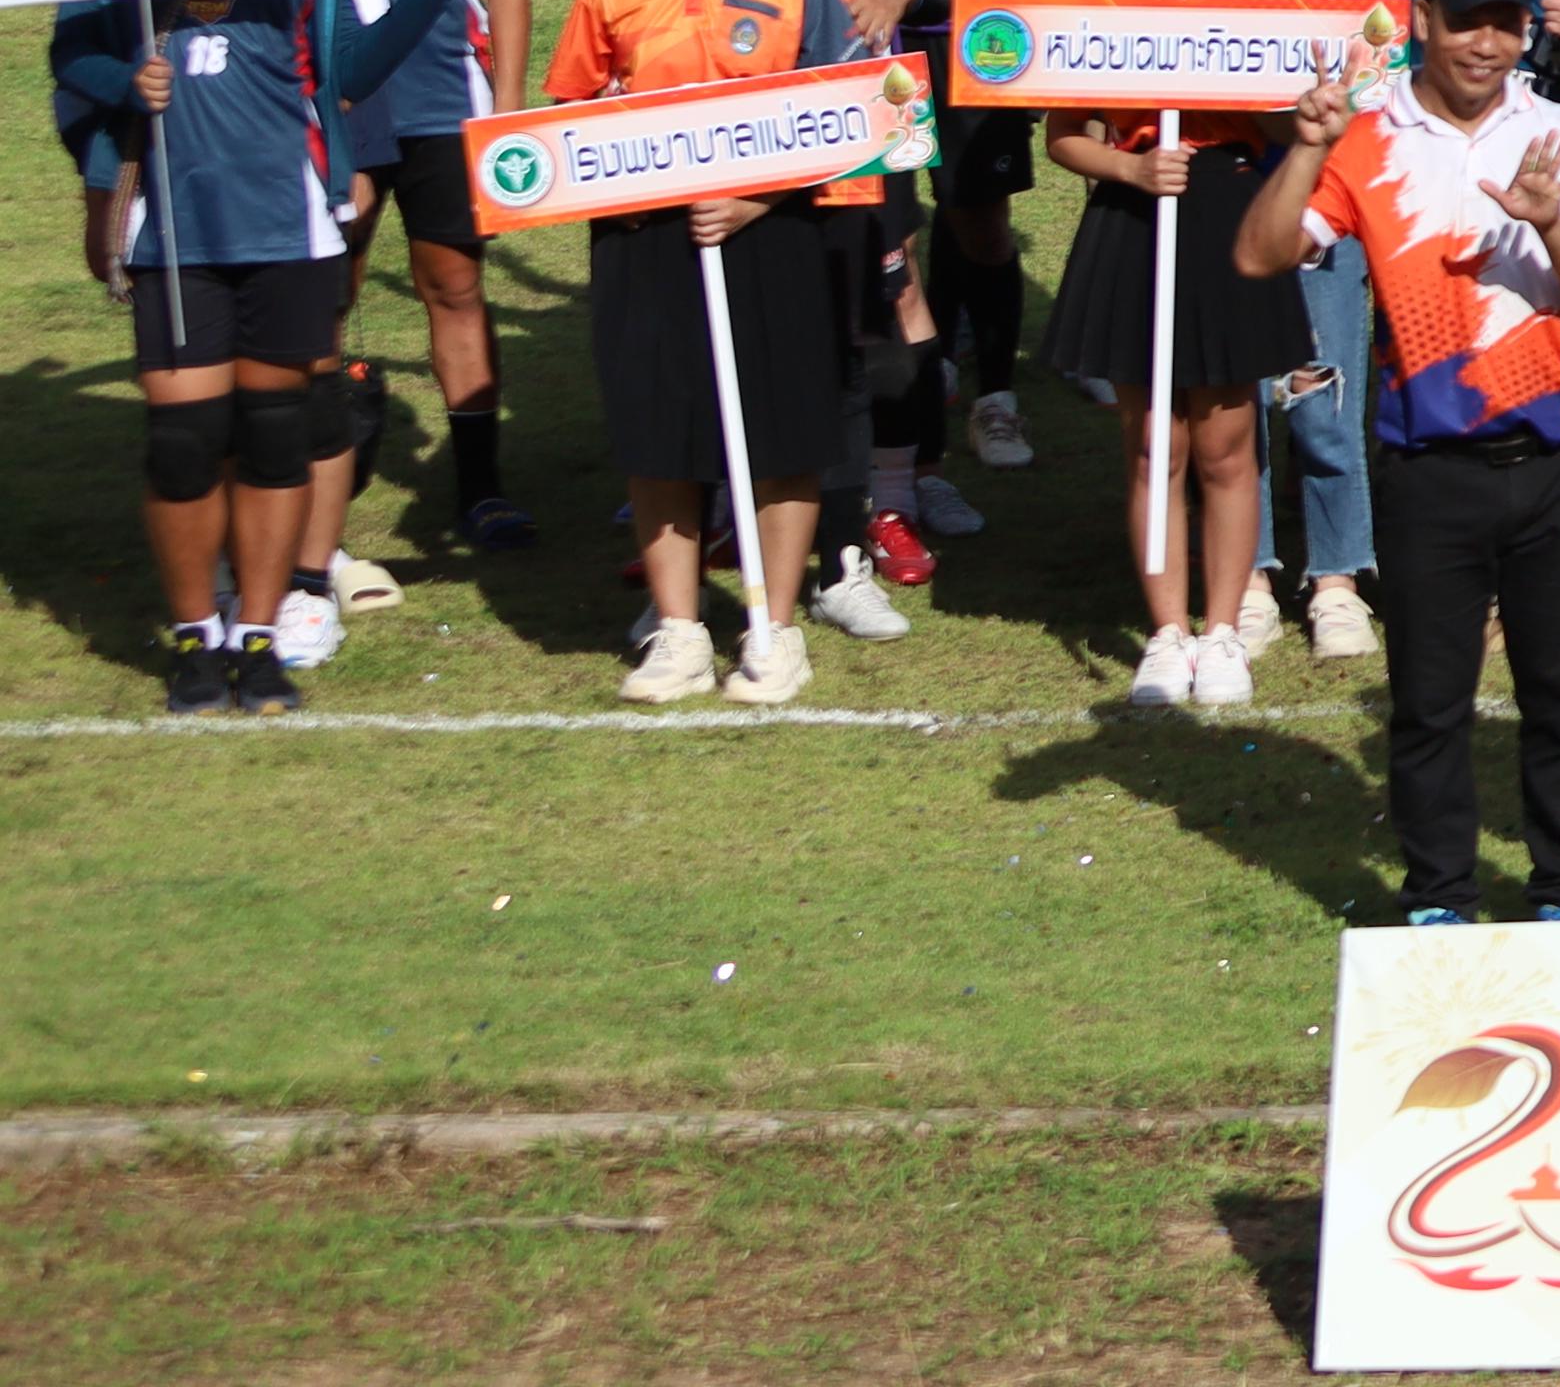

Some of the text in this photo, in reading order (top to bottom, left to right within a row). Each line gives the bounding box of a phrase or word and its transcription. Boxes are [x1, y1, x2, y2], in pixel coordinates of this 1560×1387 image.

[561, 99, 870, 184] โรงพยาบาลแม่สอด
